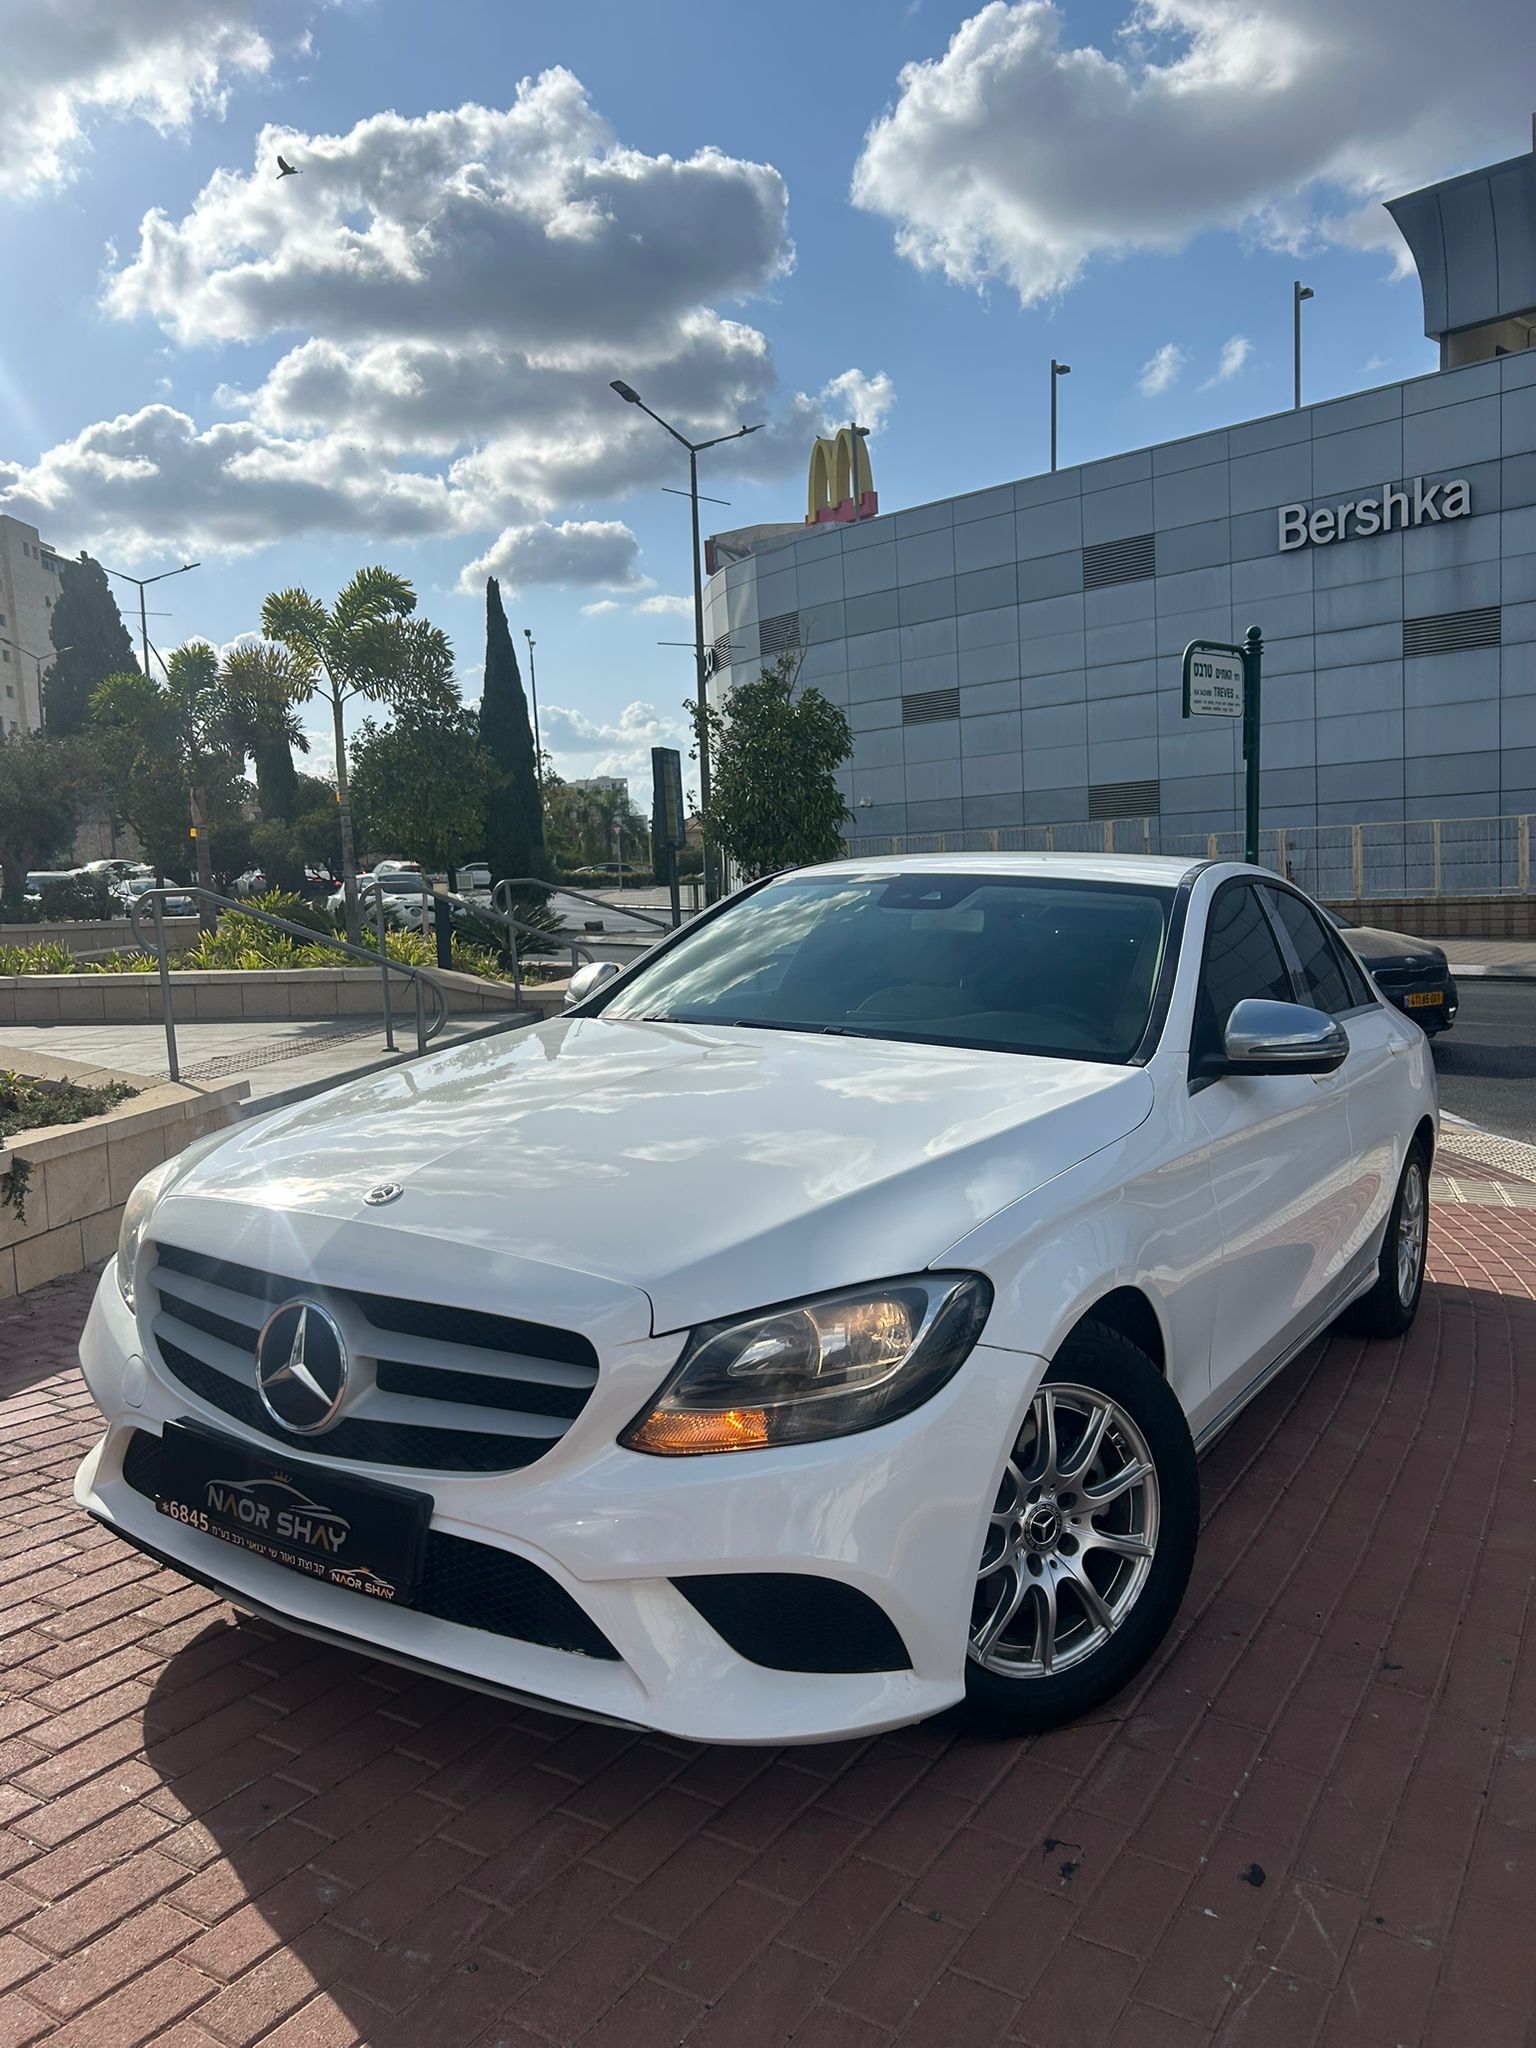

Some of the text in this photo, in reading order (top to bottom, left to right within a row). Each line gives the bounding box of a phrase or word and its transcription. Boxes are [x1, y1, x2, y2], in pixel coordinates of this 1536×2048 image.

[1279, 477, 1472, 551] Bershka
[1213, 686, 1234, 699] TREVES
[208, 1485, 346, 1552] NAOR SHAY
[231, 1533, 245, 1546] רכב
[280, 1551, 296, 1565] נאור
[298, 1557, 325, 1575] קבוצת
[331, 1572, 394, 1600] NAOR SHAY
